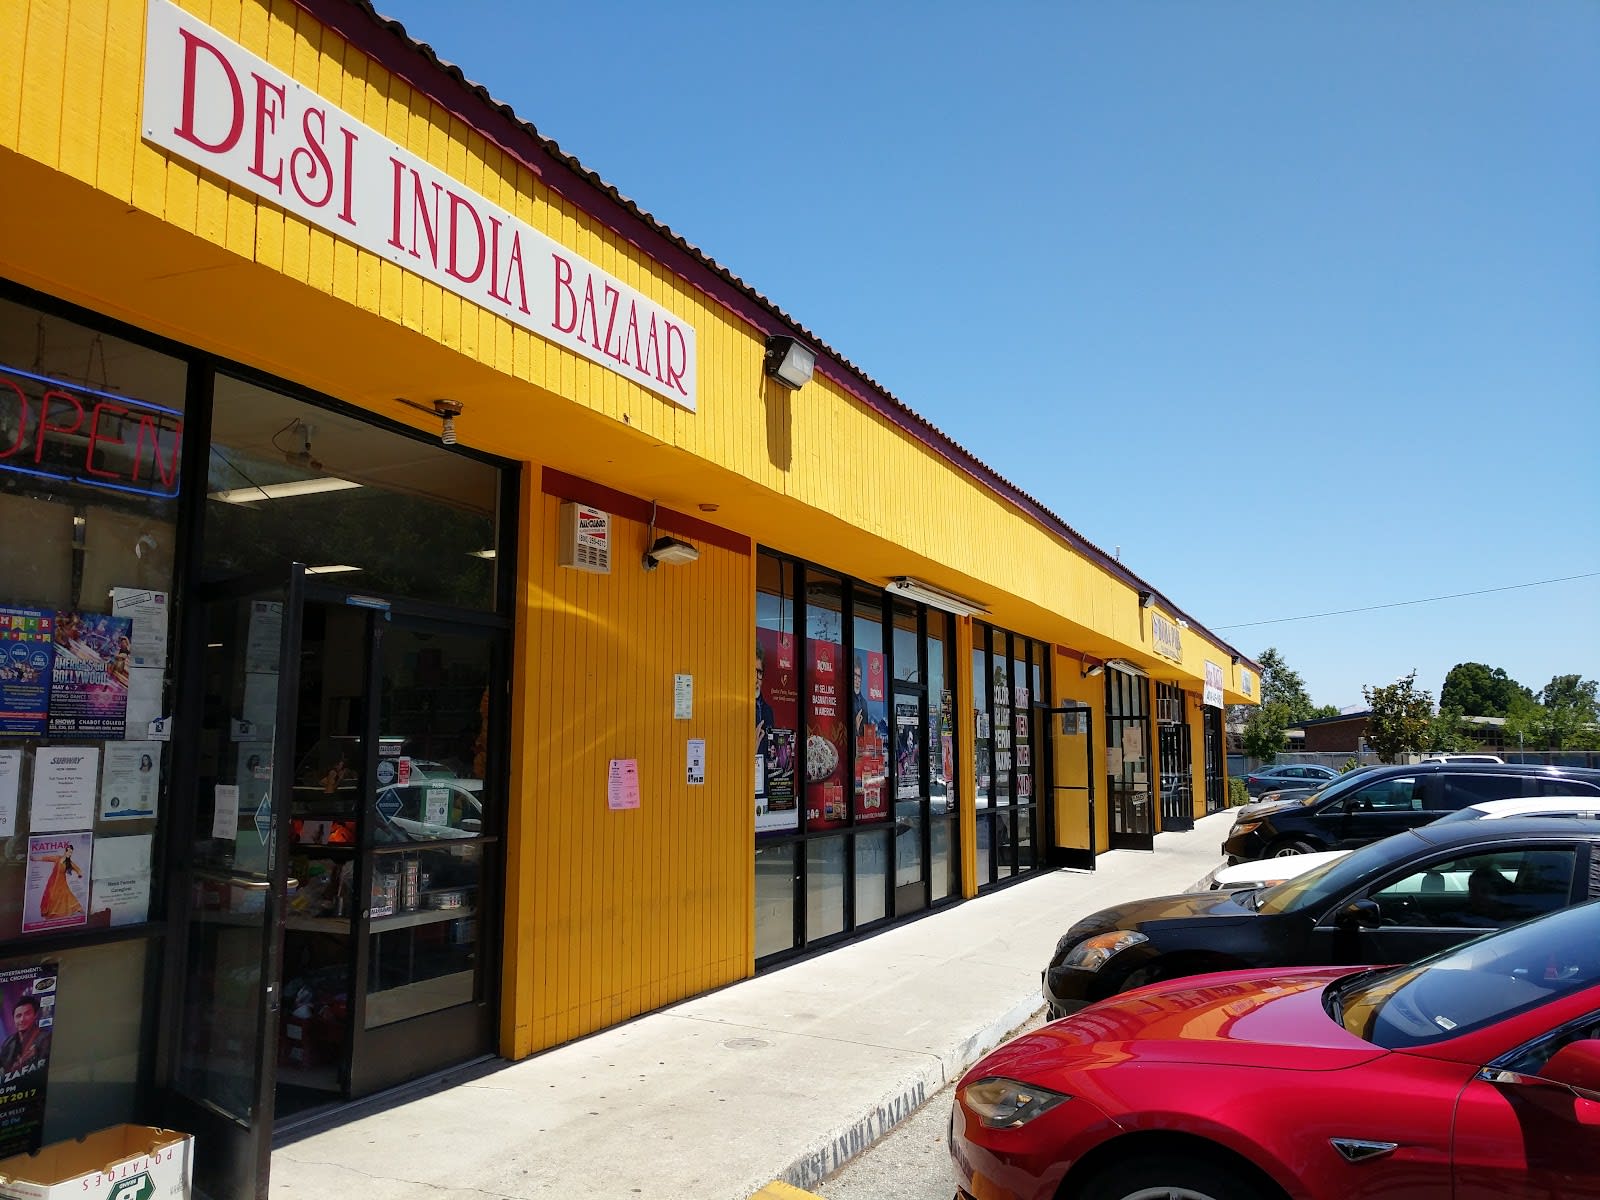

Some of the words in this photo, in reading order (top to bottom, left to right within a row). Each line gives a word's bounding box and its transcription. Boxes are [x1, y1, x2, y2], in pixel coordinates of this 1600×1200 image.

[174, 27, 358, 227] DESI
[388, 156, 532, 316] INDIA
[552, 254, 689, 396] BAZAAR
[50, 756, 84, 765] SUBWAY
[4, 1058, 46, 1084] ZAFAR
[10, 1088, 36, 1102] 2017
[832, 1116, 875, 1170] INDIA
[876, 1081, 926, 1137] BAZAAR
[83, 1149, 173, 1192] POTATOES
